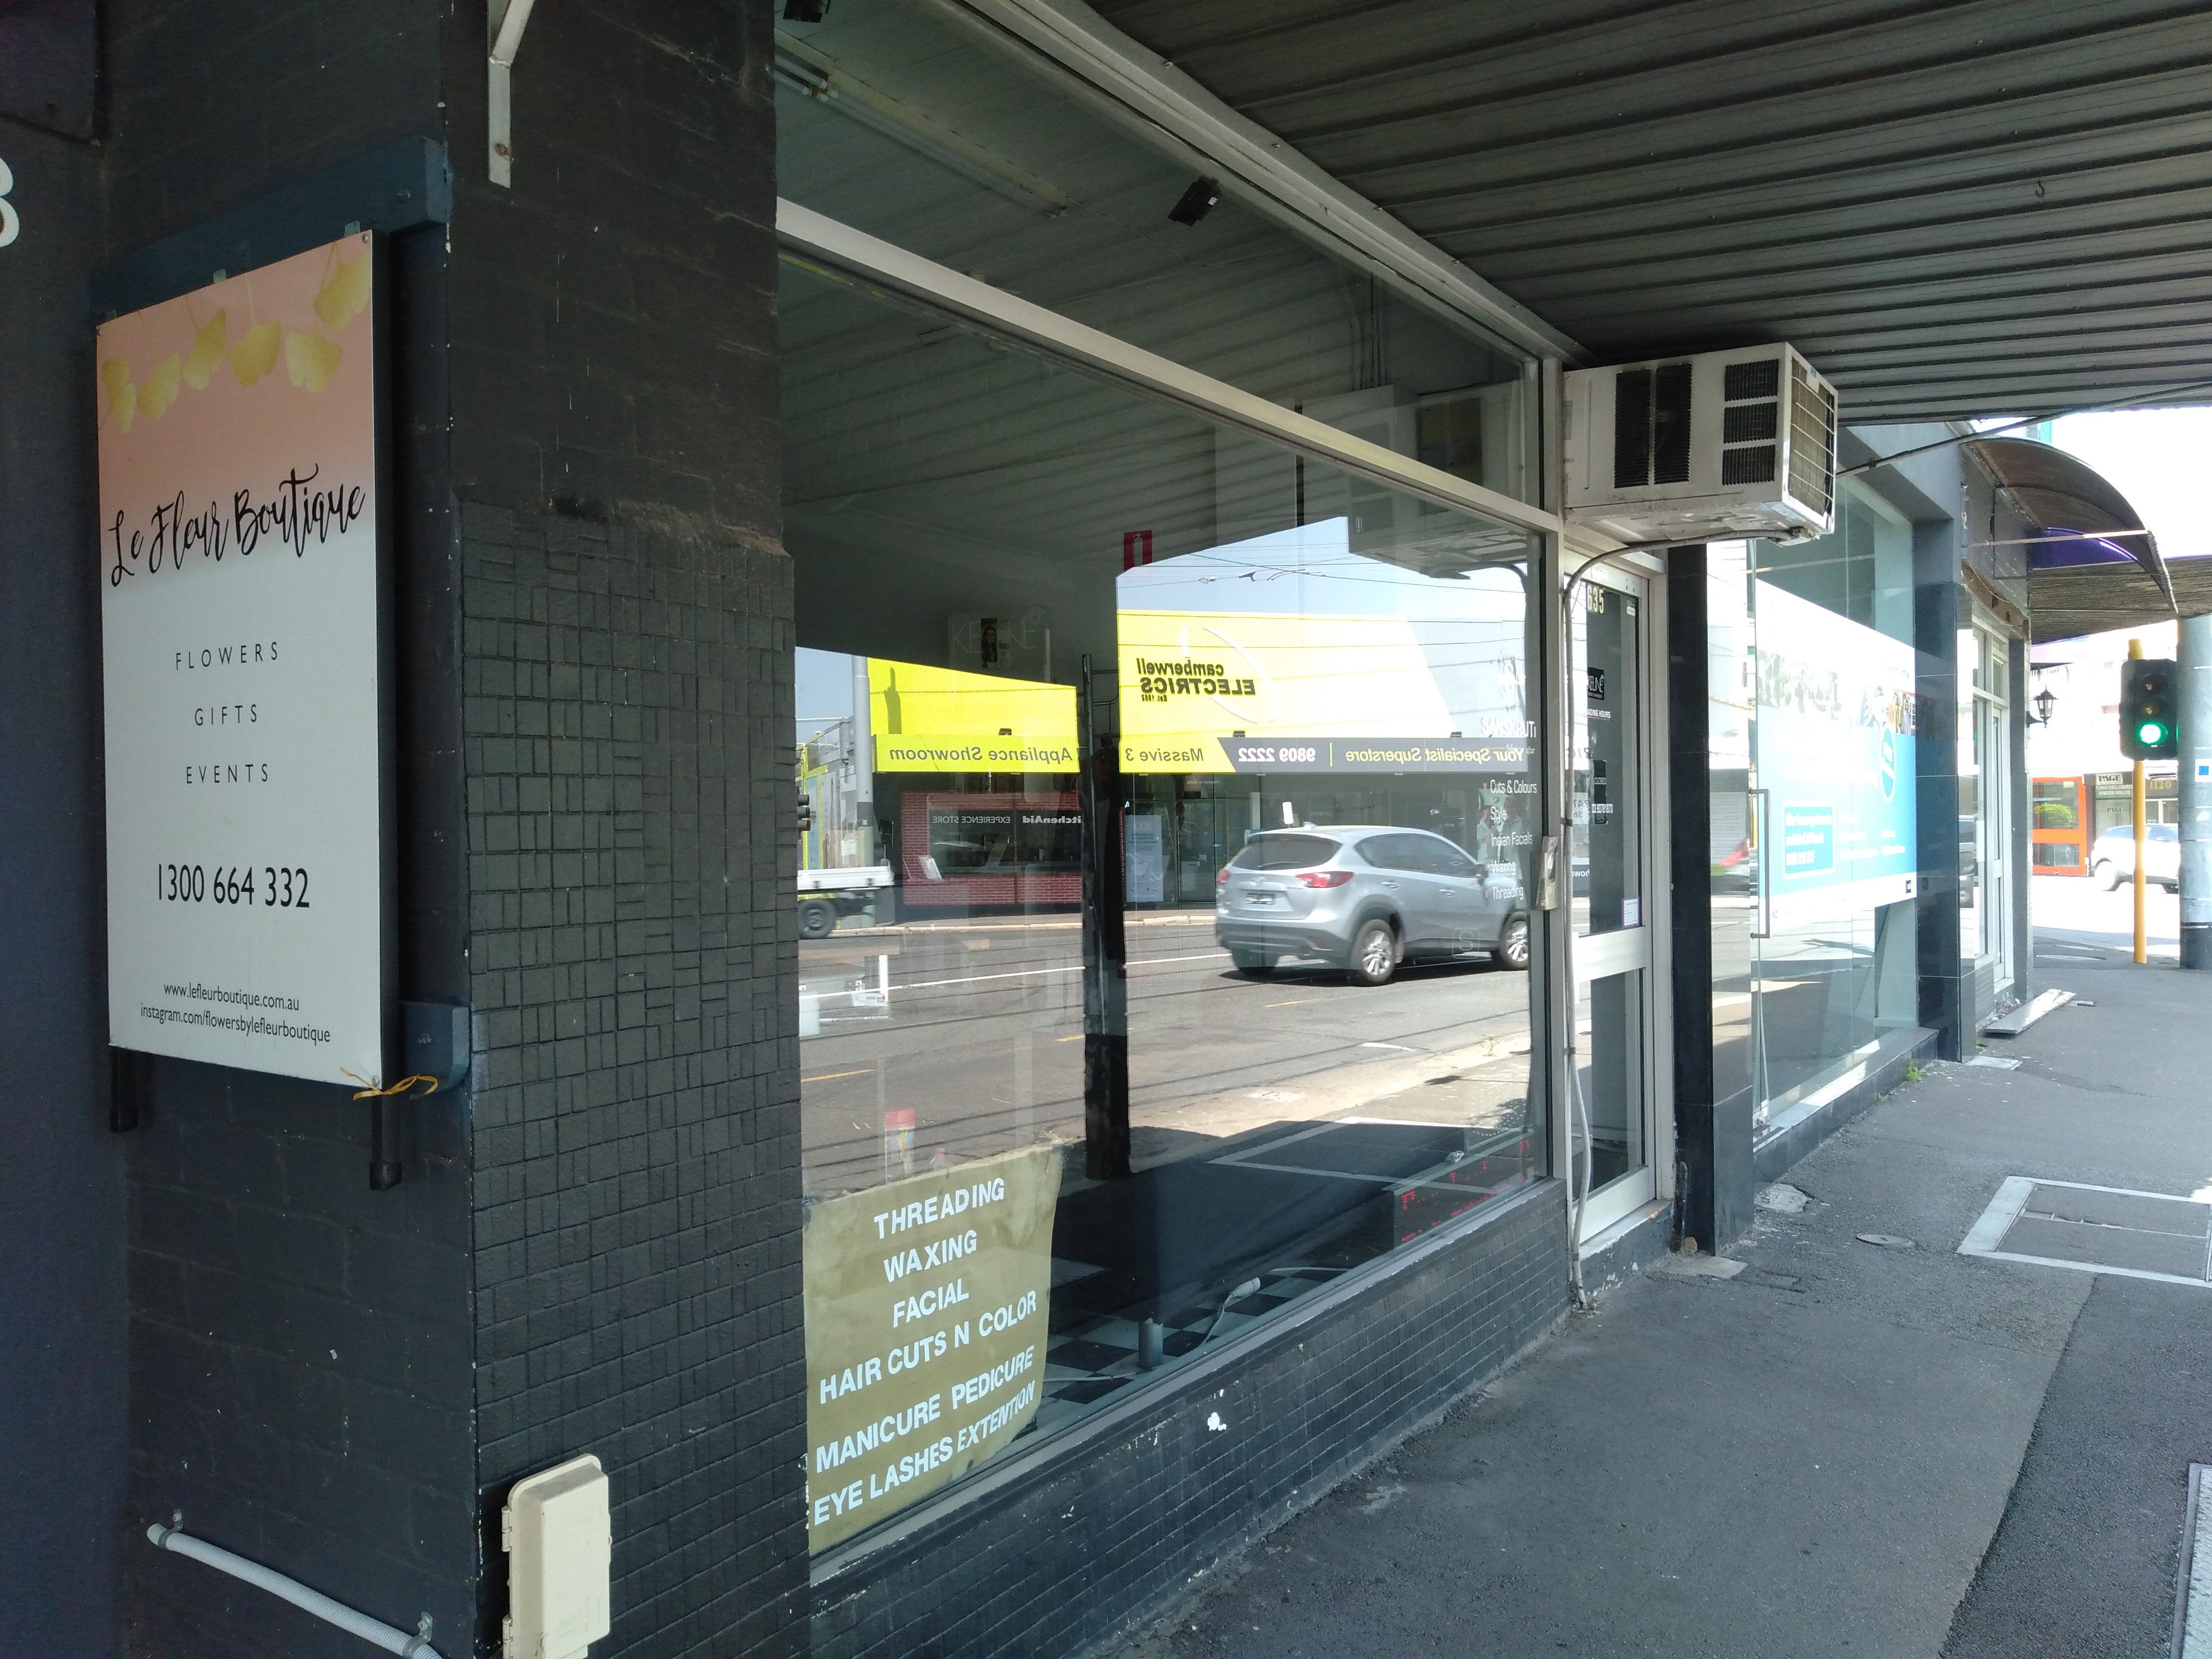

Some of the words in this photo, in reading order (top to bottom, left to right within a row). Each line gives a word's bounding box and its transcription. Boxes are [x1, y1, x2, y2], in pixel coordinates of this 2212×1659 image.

[108, 510, 144, 587] Le
[149, 490, 229, 574] Fleur
[234, 463, 366, 557] Boutique
[1587, 584, 1604, 615] 635
[175, 641, 278, 671] FLOWERS
[195, 703, 258, 726] GIFTS
[1598, 710, 1611, 718] HOURS
[186, 763, 269, 784] EVENTS
[1490, 779, 1505, 793] Cuts
[1507, 780, 1513, 793] &
[1514, 780, 1537, 793] Colours
[2150, 781, 2172, 790] 1120
[1491, 833, 1510, 847] Indian
[1512, 831, 1533, 845] Facials
[1492, 859, 1516, 875] Waxing
[158, 864, 205, 903] 1300
[213, 866, 255, 905] 664
[265, 867, 310, 908] 332
[1492, 886, 1524, 900] Threading
[163, 982, 300, 1011] www.lefleurboutique.com.au
[140, 1002, 331, 1046] instagram.com/flowersbylefleurboutique
[874, 1177, 1005, 1239] THREADING
[883, 1229, 977, 1283] WAXING
[893, 1278, 969, 1328] FACIAL
[819, 1357, 882, 1404] HAIR
[887, 1330, 947, 1375] CUTS
[953, 1320, 970, 1350] N
[979, 1289, 1037, 1337] COLOR
[816, 1393, 941, 1473] MANICURE
[952, 1345, 1035, 1411] PEDICURE
[814, 1480, 864, 1526] EYE
[869, 1436, 953, 1500] LASHES
[957, 1380, 1036, 1454] EXTENTION
